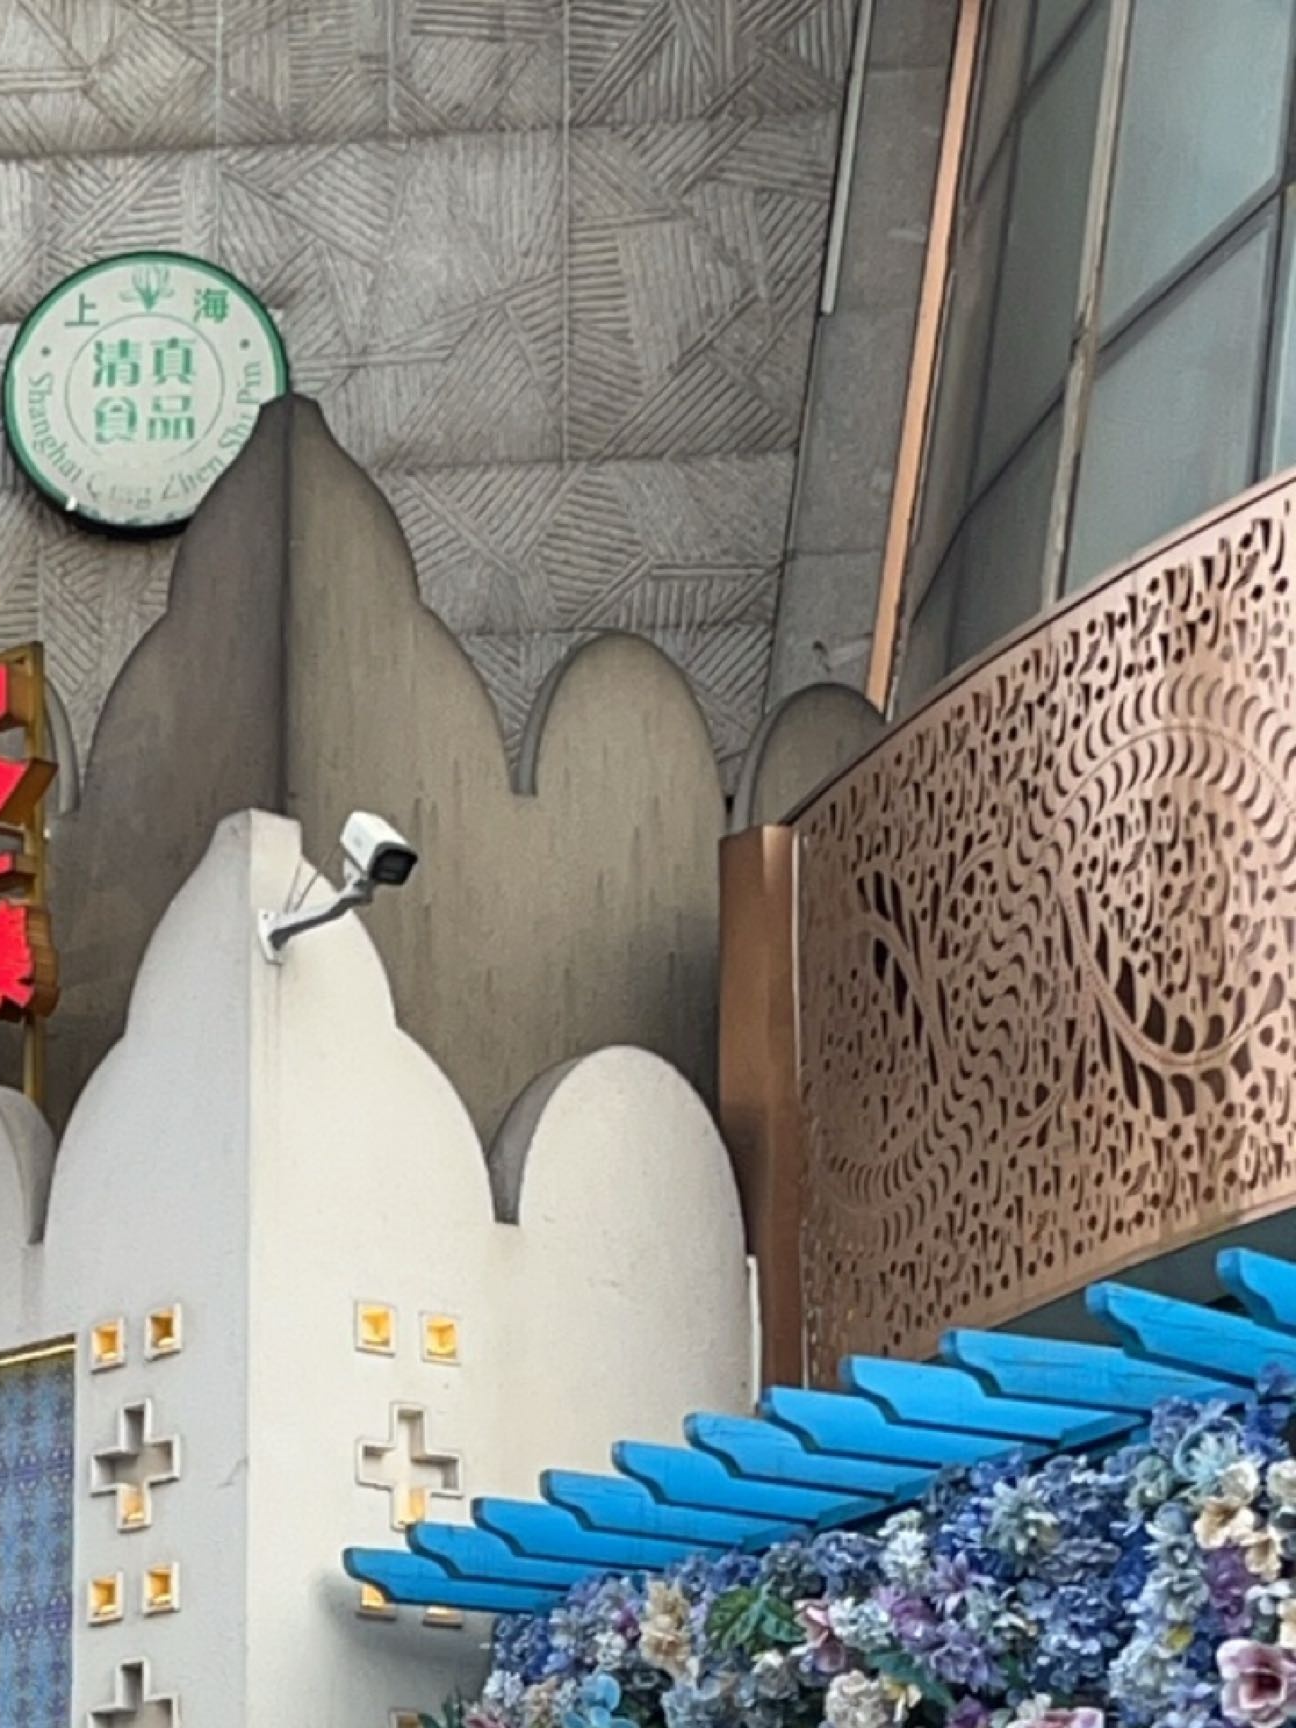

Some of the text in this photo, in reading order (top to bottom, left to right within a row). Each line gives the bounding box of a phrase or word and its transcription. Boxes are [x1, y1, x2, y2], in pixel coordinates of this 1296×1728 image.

[93, 337, 197, 388] 清真
[28, 371, 83, 485] Shanghai
[94, 394, 196, 444] 食品
